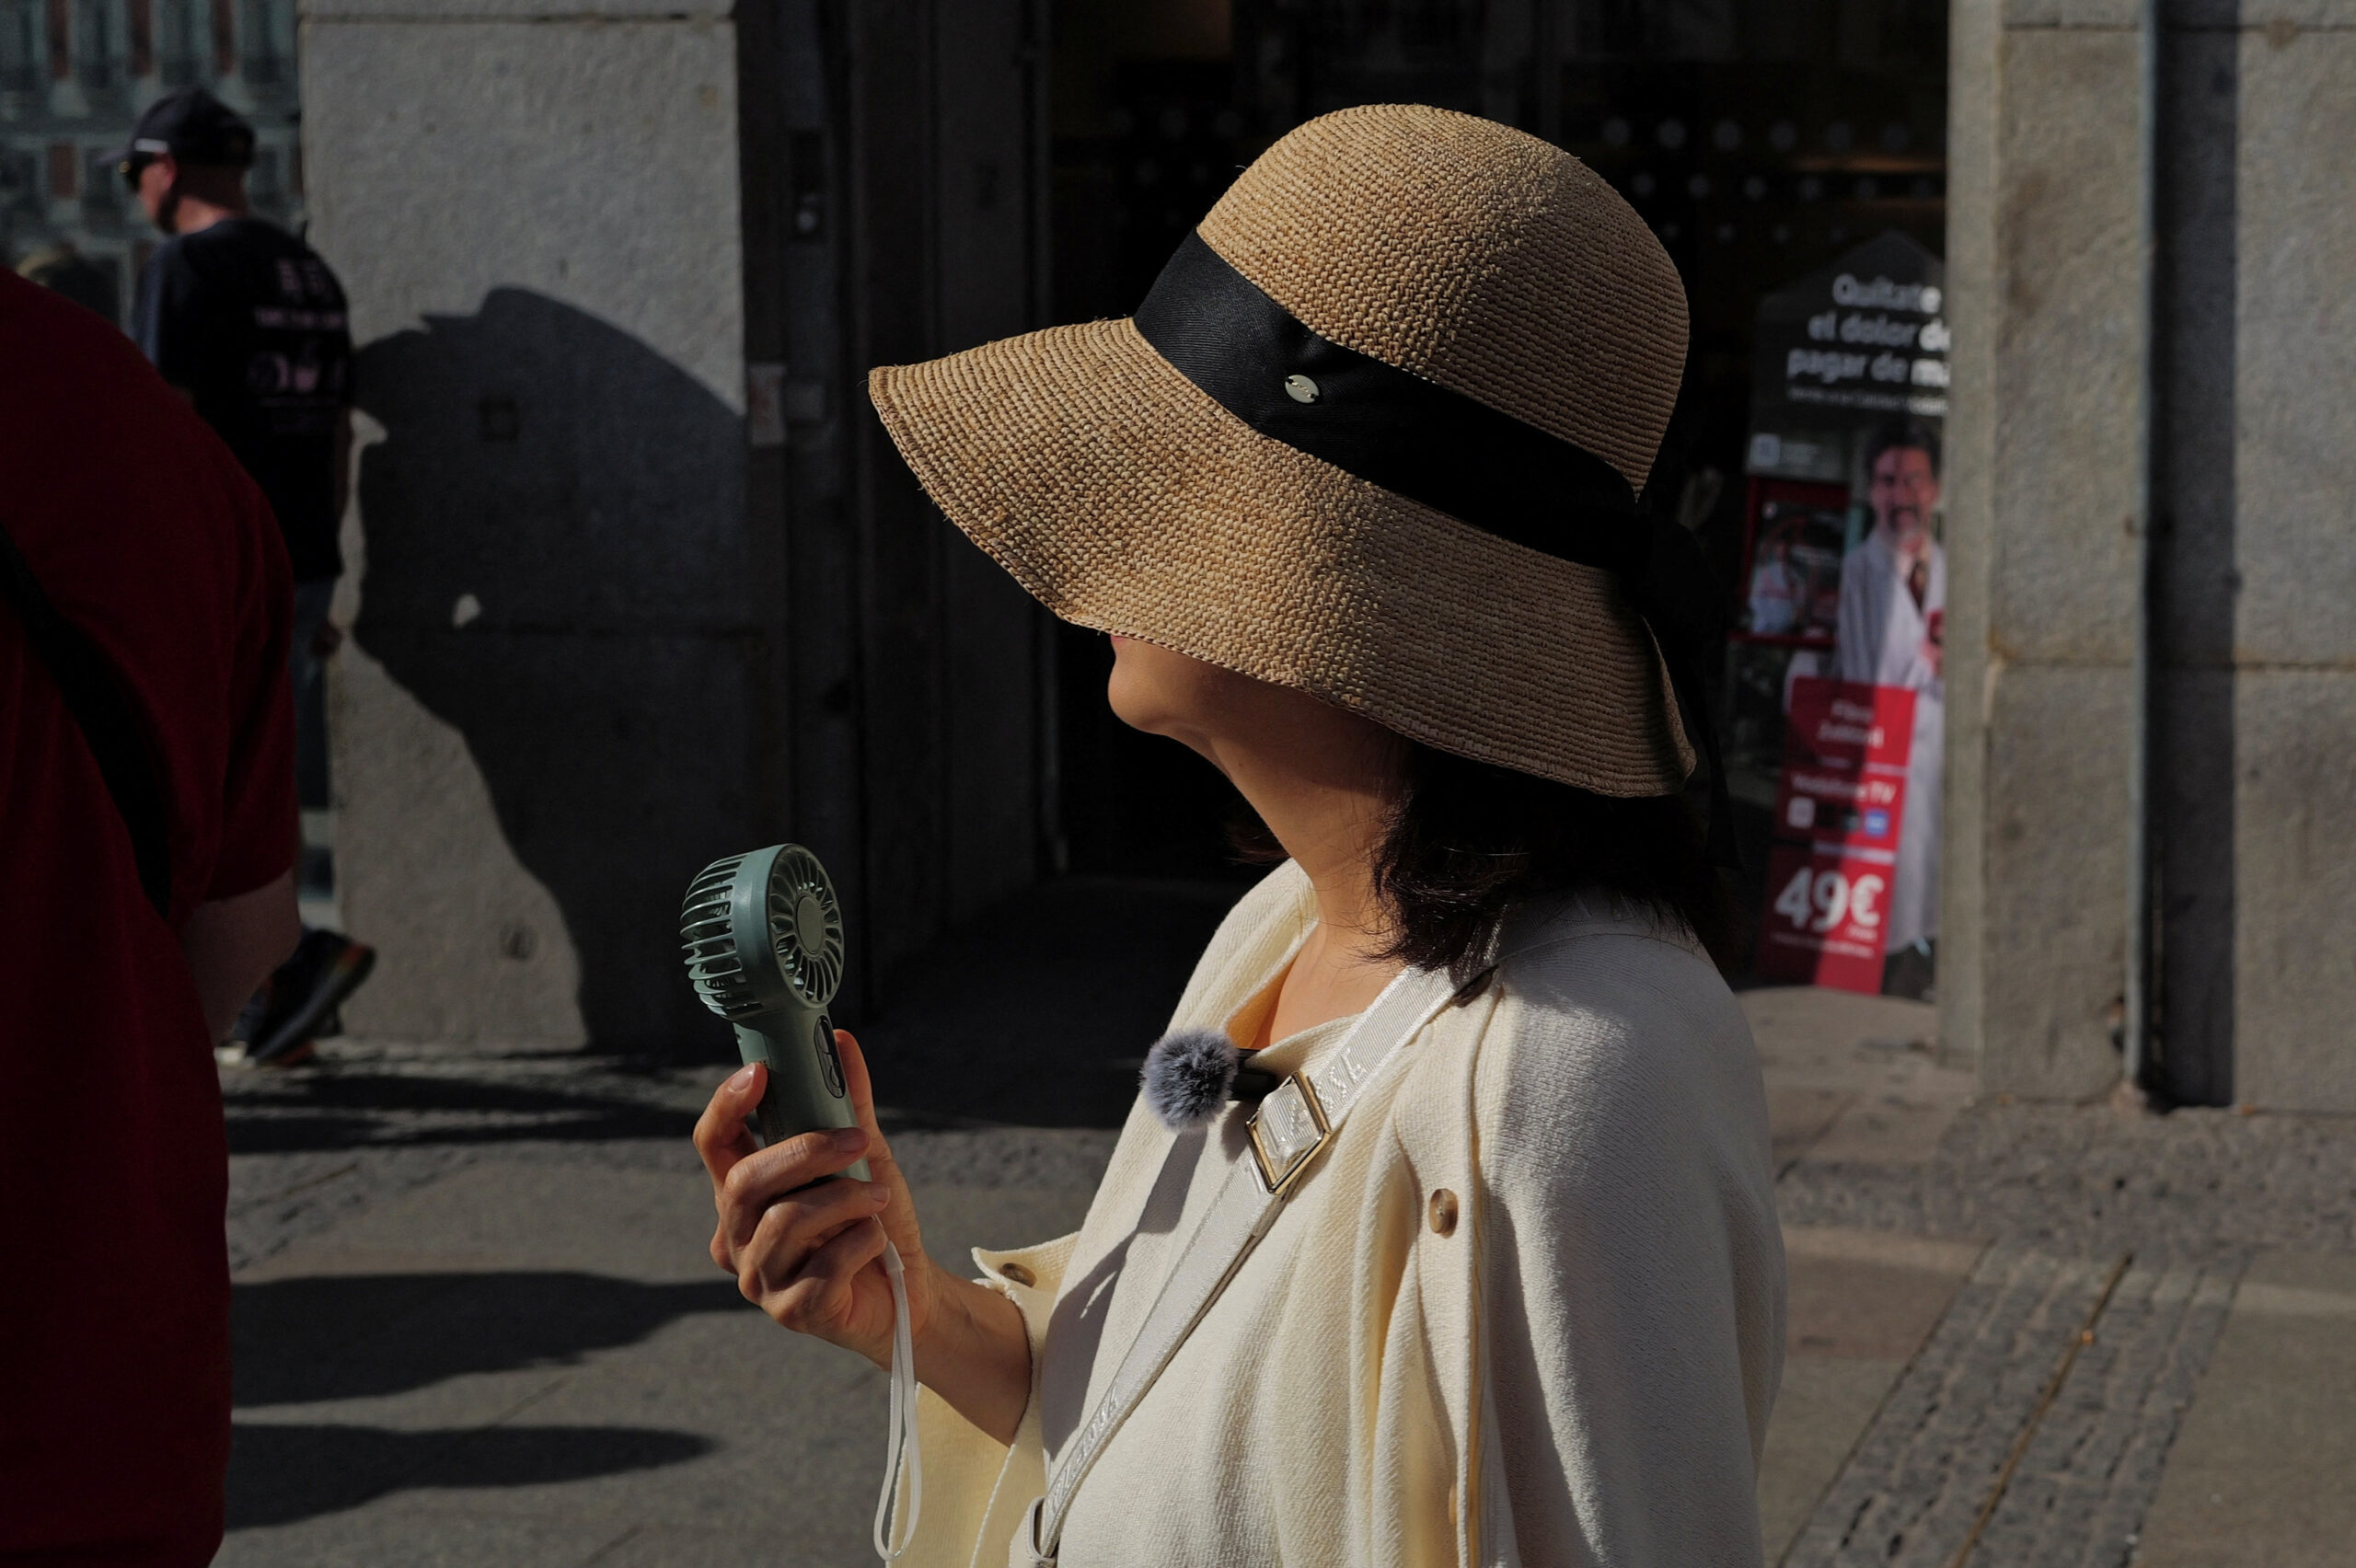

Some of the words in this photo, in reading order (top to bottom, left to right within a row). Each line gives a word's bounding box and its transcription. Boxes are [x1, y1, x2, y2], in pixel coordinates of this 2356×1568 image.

[1807, 309, 1837, 342] el
[1840, 312, 1918, 348] dolor
[1786, 348, 1866, 384] pagar
[1870, 351, 1909, 383] de
[1773, 866, 1885, 933] 49€
